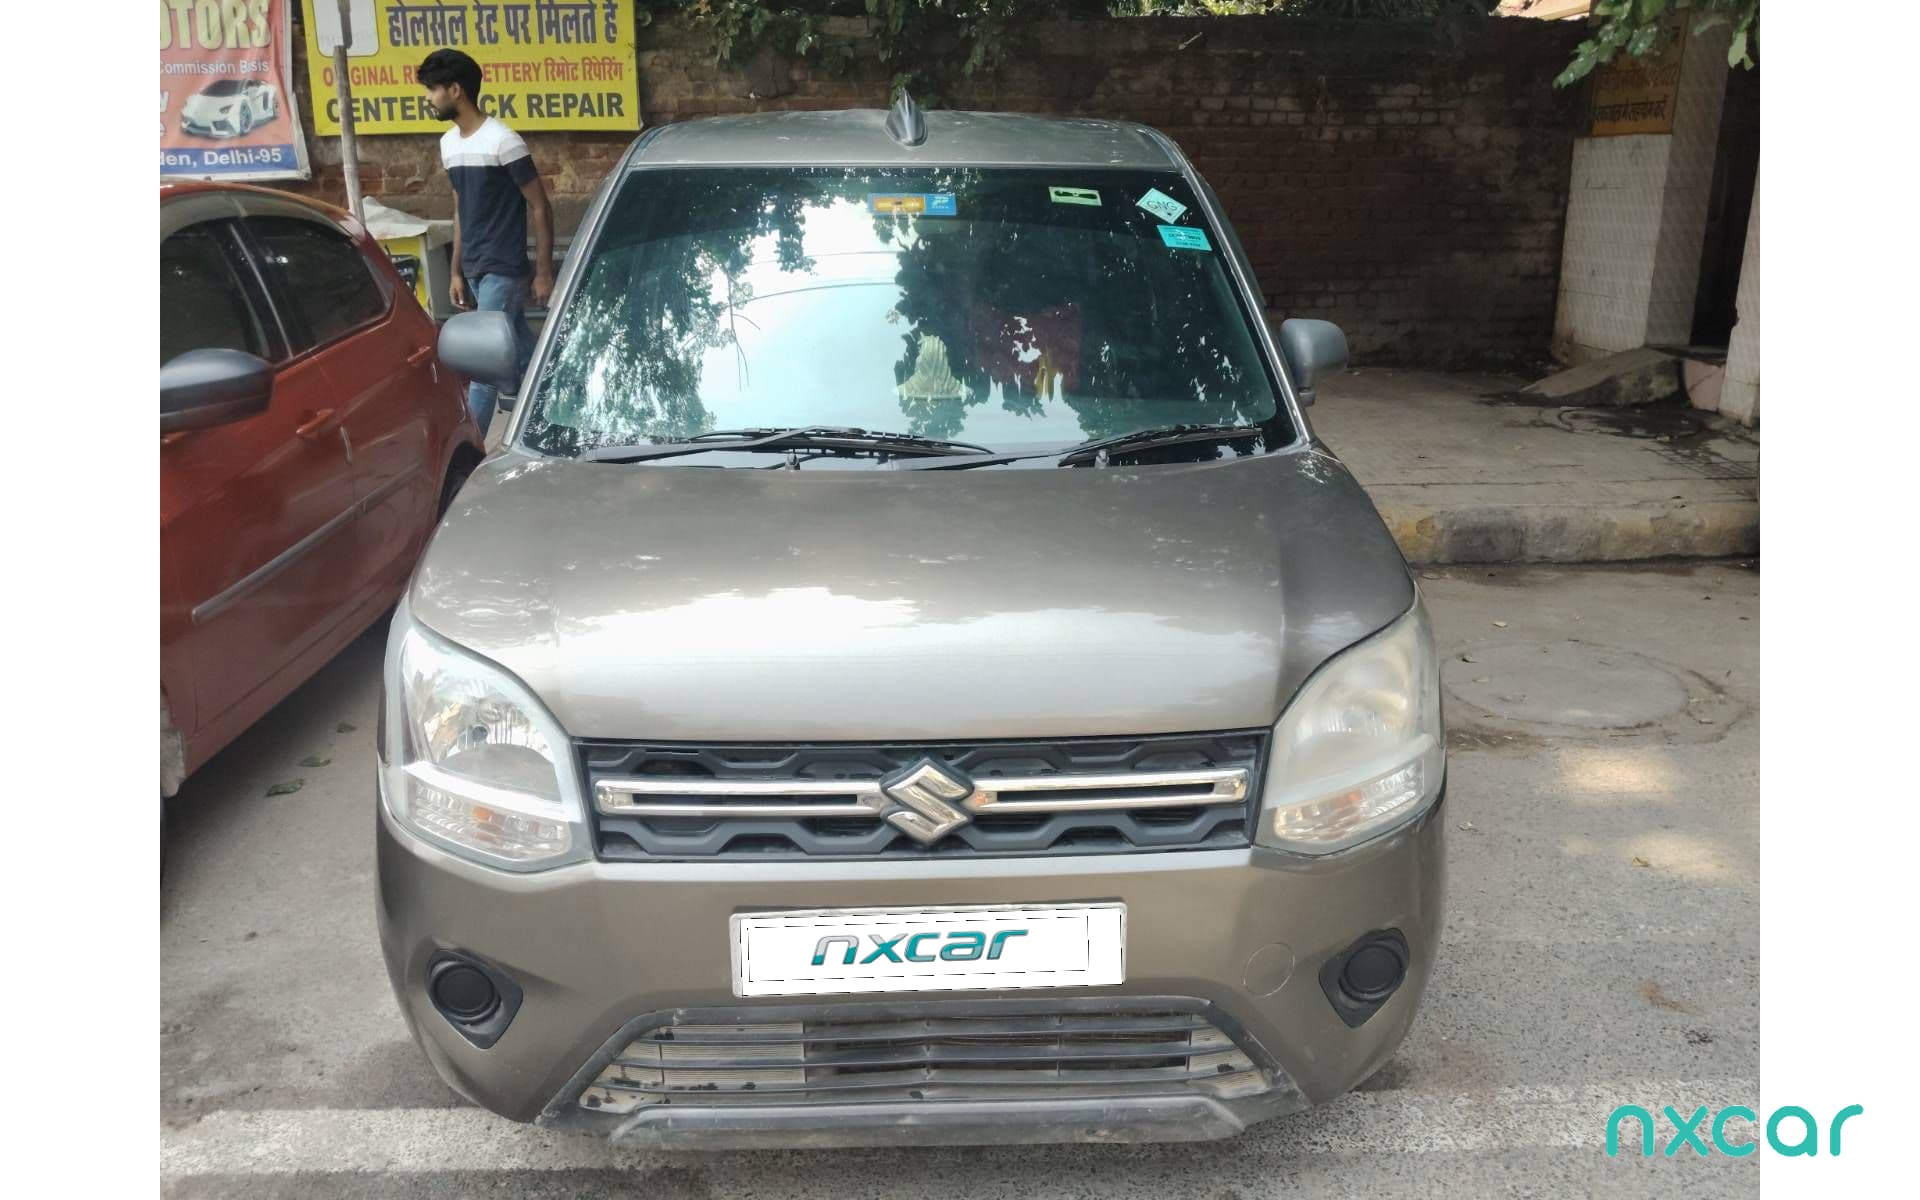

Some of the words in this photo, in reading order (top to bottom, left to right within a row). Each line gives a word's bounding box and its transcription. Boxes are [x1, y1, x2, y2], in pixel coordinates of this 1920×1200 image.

[385, 0, 468, 46] होलसेल
[473, 0, 499, 45] रेट
[503, 4, 531, 45] पर
[322, 64, 399, 87] OGINAL
[482, 62, 541, 83] ETTERY
[544, 56, 579, 82] रिमोट
[526, 92, 625, 119] REPAIR
[203, 148, 282, 165] Delhi-95
